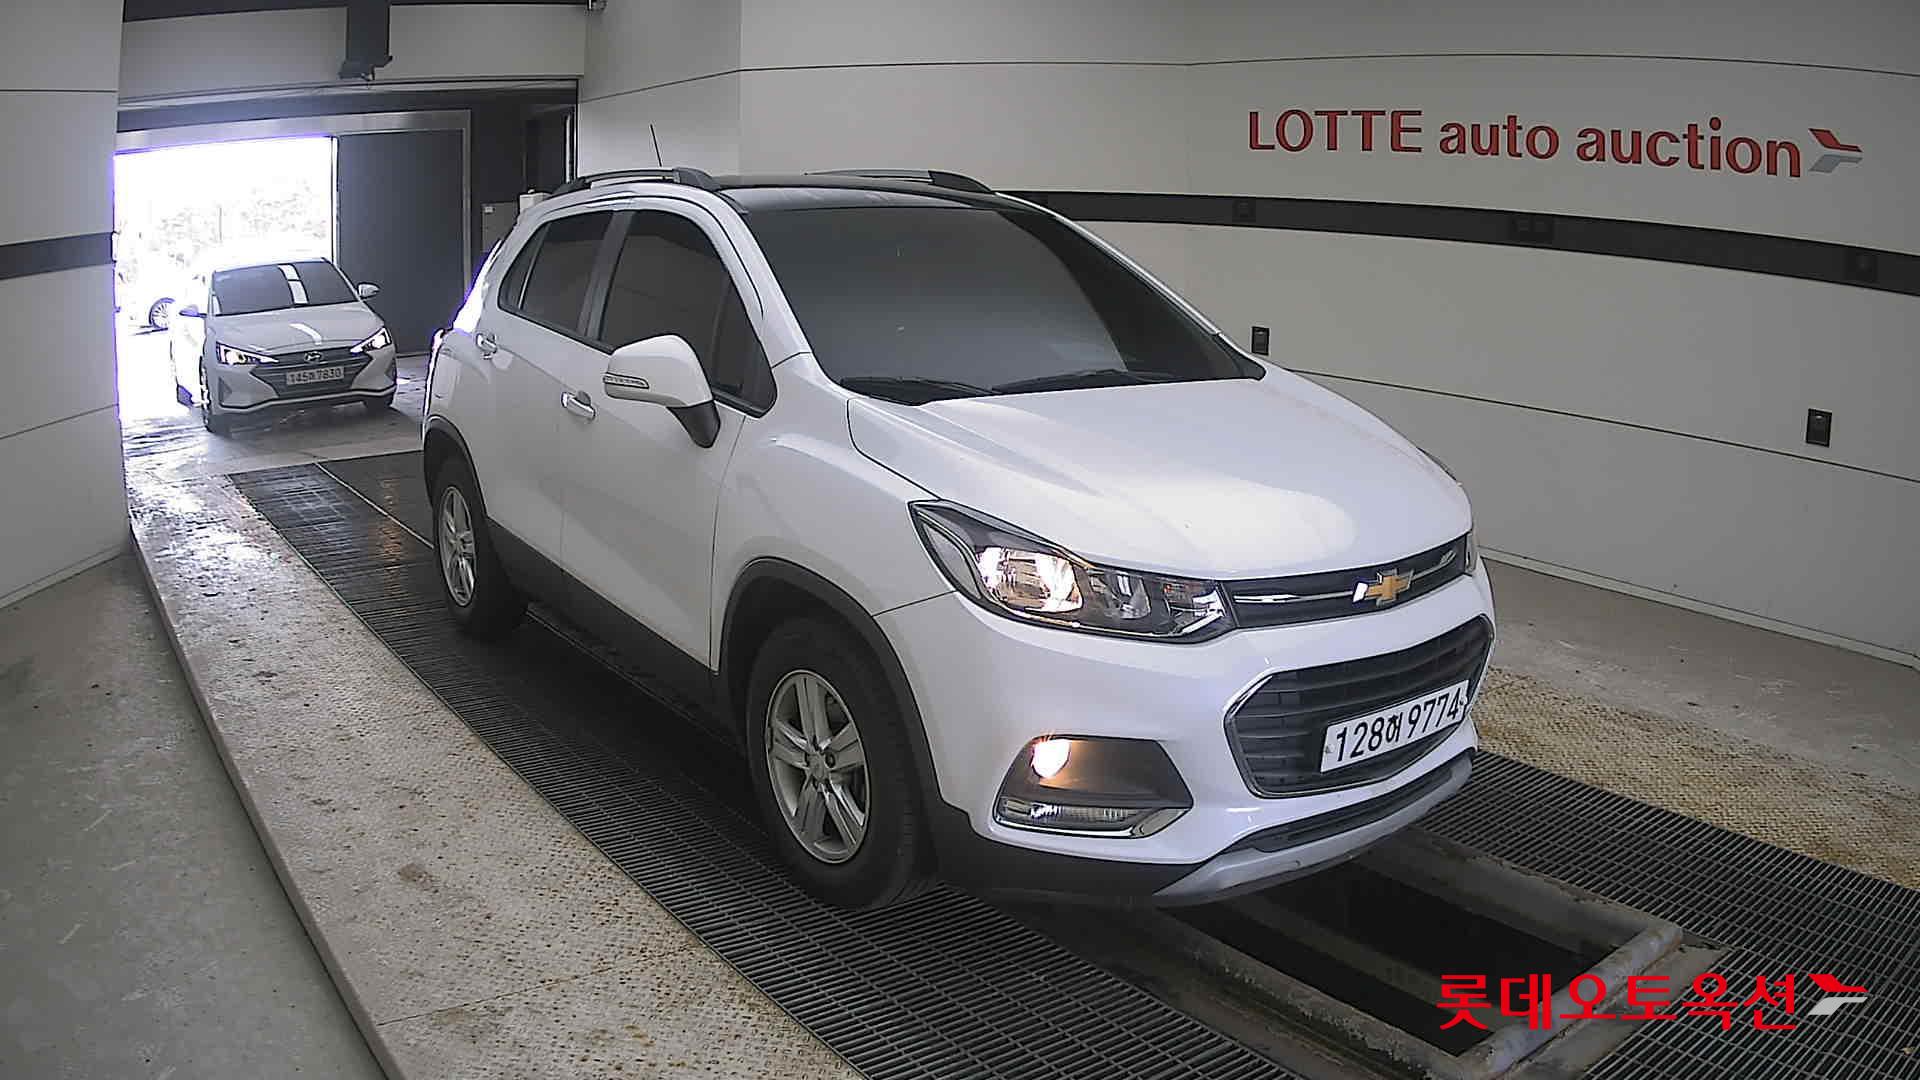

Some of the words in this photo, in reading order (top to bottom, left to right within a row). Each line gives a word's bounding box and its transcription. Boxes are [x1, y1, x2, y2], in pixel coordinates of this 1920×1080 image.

[1248, 110, 1423, 152] LOTTE
[1438, 115, 1560, 159] auto
[1576, 117, 1802, 177] auction
